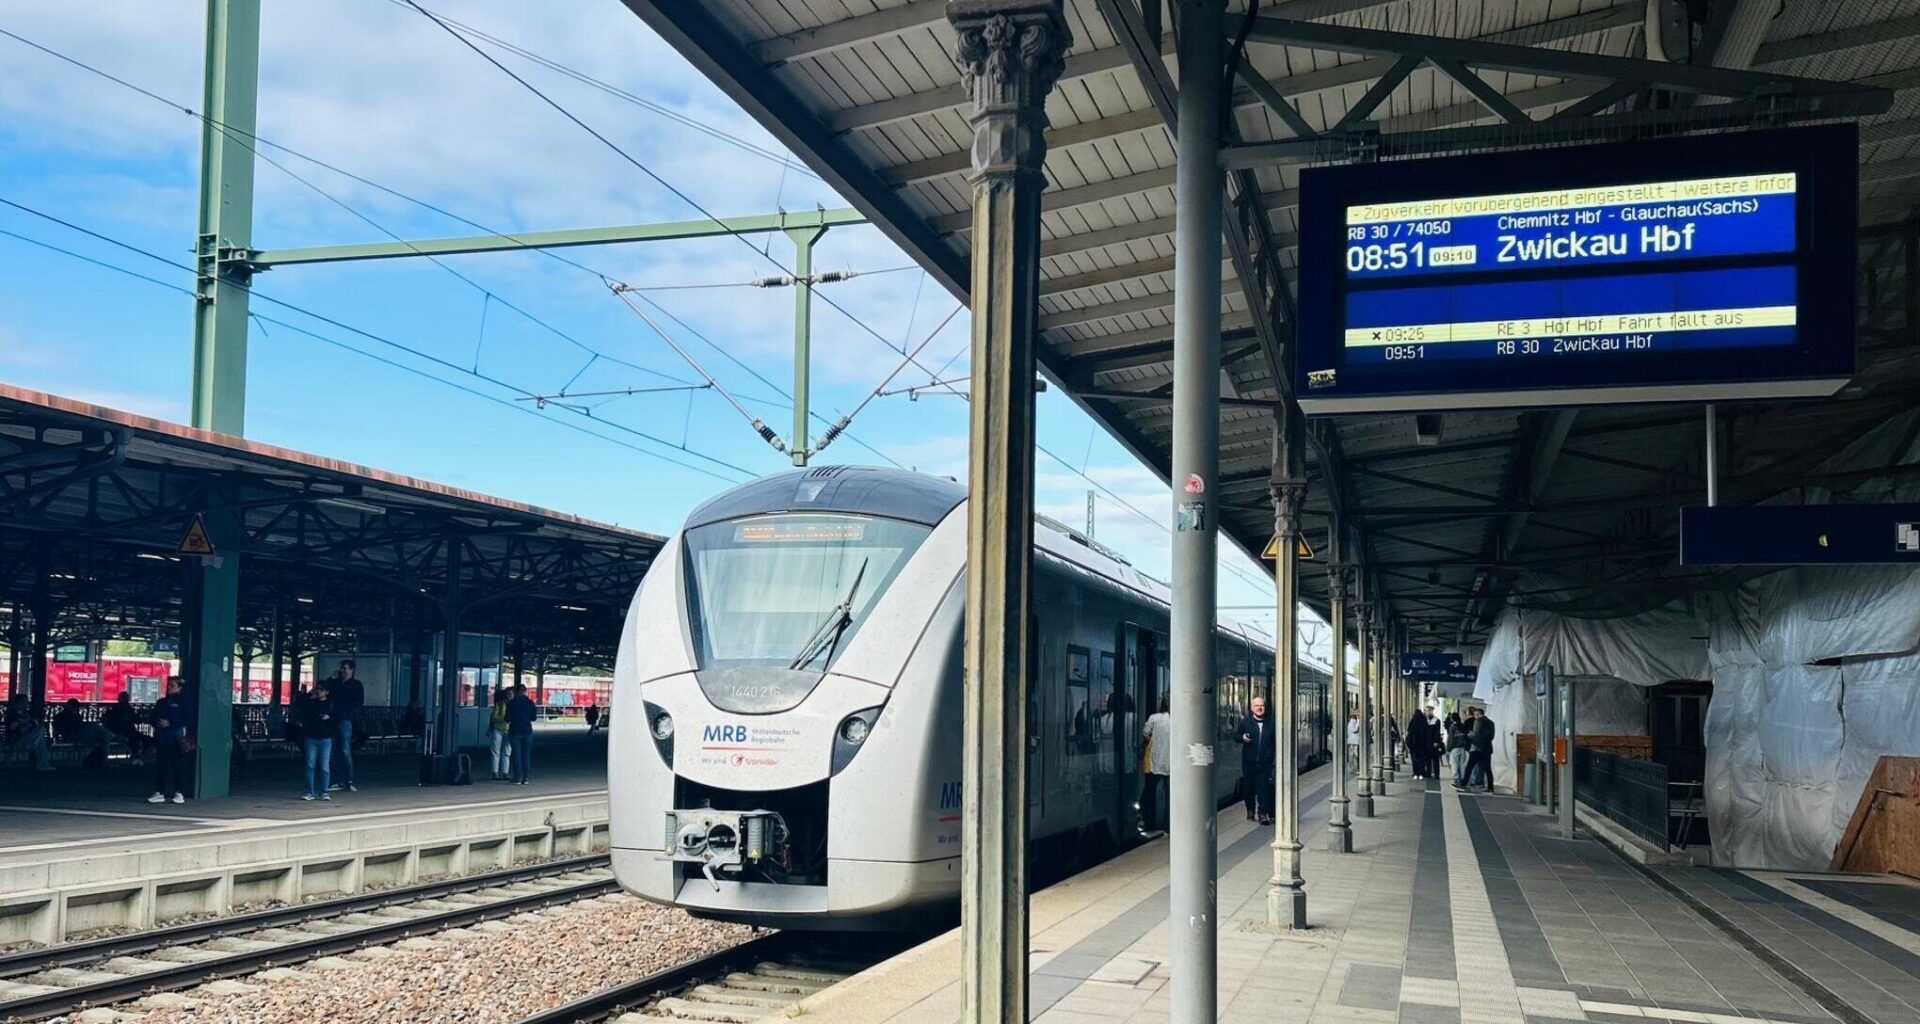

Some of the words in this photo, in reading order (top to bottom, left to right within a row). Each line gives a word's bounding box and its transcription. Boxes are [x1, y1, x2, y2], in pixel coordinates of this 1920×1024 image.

[1364, 201, 1448, 221] Zugverkehr
[1575, 185, 1665, 205] eingestellt
[1497, 213, 1569, 230] Chemnitz
[1575, 210, 1601, 225] Hbf
[1621, 198, 1759, 222] Glauchau(Sachs)
[1348, 227, 1366, 240] RB
[1371, 225, 1388, 239] 30
[1393, 223, 1402, 238] /
[1407, 220, 1451, 237] 74050
[1497, 230, 1628, 263] Zwickau
[1640, 222, 1695, 253] Hbf
[1346, 241, 1424, 272] 08:51
[1433, 250, 1473, 263] 09:10
[1497, 322, 1515, 335] RE
[1522, 322, 1531, 335] 3
[1577, 317, 1604, 332] Hbf
[1618, 314, 1663, 331] Fahrt
[1714, 312, 1744, 326] aus
[1385, 327, 1425, 343] 09:25
[1496, 341, 1516, 356] RB
[1521, 339, 1540, 354] 30
[1553, 335, 1620, 353] Zwickau
[1625, 334, 1654, 350] Hbf
[1384, 345, 1425, 361] 09:51
[731, 685, 758, 698] 1440
[702, 724, 748, 743] MRB
